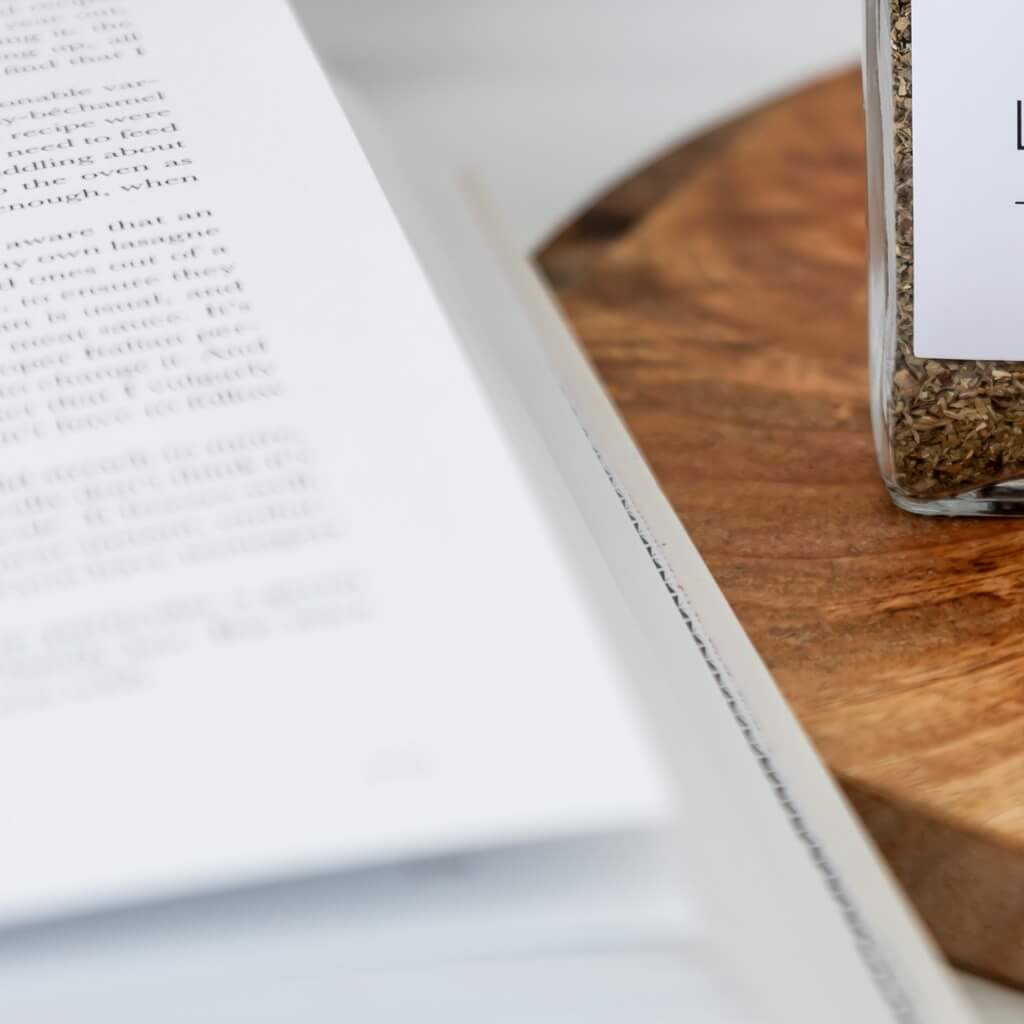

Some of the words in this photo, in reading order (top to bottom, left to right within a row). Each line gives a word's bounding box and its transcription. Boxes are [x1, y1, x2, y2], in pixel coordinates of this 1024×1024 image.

[10, 120, 96, 140] recipe
[104, 109, 172, 125] were
[7, 138, 75, 158] need
[83, 135, 111, 146] to
[120, 122, 179, 140] feed
[103, 140, 186, 160] about
[22, 178, 67, 191] the
[81, 164, 149, 181] oven
[163, 158, 193, 168] as
[120, 174, 199, 193] when
[6, 227, 96, 251] aware
[110, 226, 221, 252] lasagne
